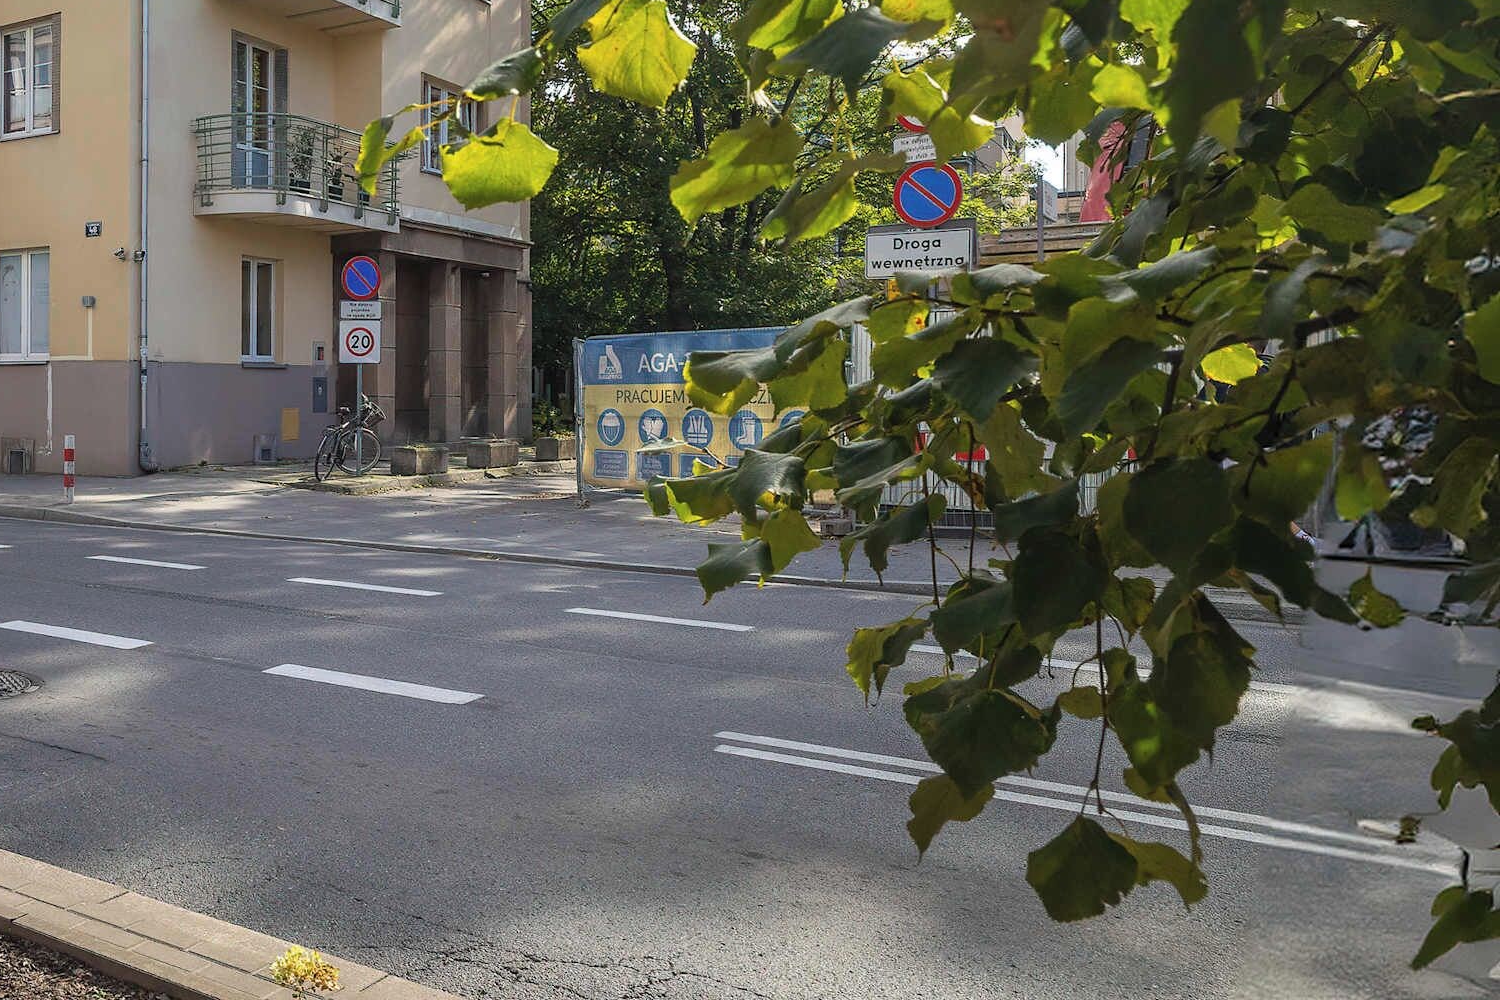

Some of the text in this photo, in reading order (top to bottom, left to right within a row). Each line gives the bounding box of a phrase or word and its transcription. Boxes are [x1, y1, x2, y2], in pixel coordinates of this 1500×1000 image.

[893, 237, 941, 252] Droga
[871, 255, 965, 270] wewnętrzna
[351, 334, 371, 349] 20
[638, 352, 691, 374] AGA-
[616, 389, 691, 404] PRACUJEM
